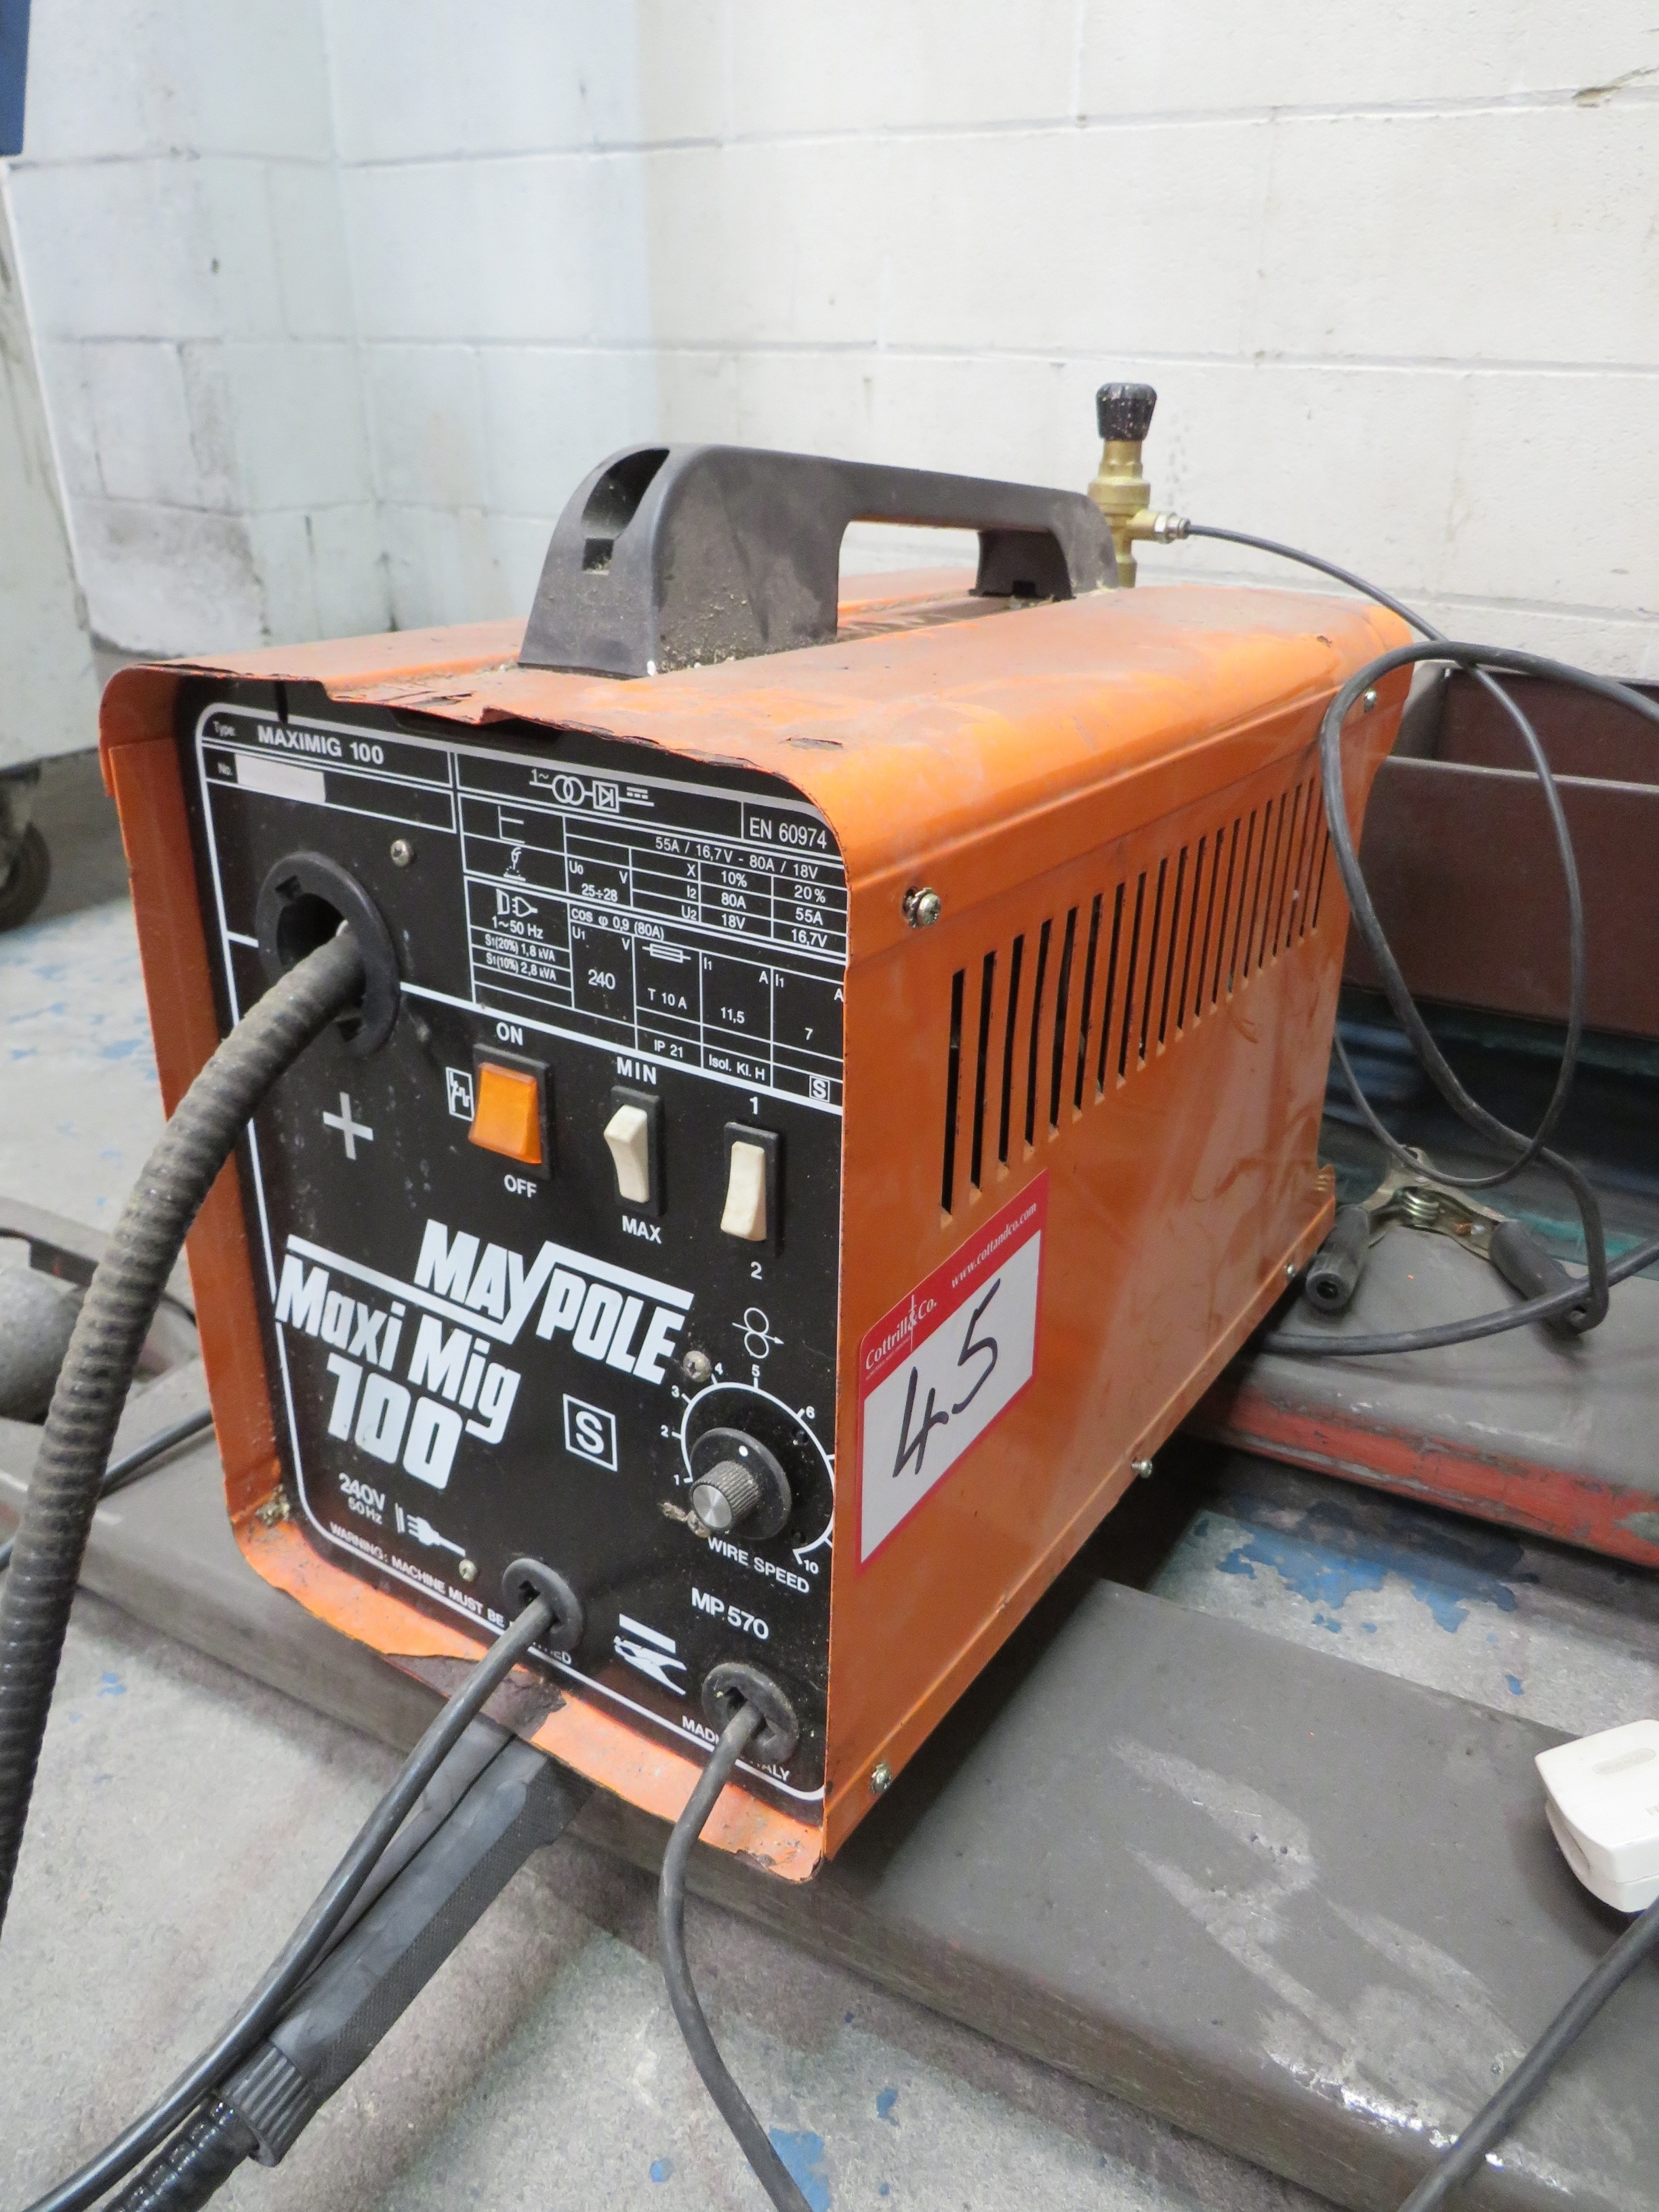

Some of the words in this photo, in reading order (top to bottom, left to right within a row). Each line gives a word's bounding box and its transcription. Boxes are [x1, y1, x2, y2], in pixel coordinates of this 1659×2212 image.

[258, 725, 342, 758] MAXIMIG
[350, 742, 385, 765] 100
[750, 817, 773, 840] EN
[779, 823, 827, 849] 60974
[655, 836, 680, 853] 55A
[750, 855, 775, 872] 80A
[794, 863, 819, 880] 18V
[619, 870, 628, 884] V
[686, 863, 697, 878] X
[721, 870, 747, 888] 10%
[794, 884, 826, 903] 20%
[721, 891, 747, 909] 80A
[795, 907, 823, 926] 55A
[527, 922, 544, 939] Hz
[612, 916, 630, 932] 0,9
[634, 920, 664, 941] (80A)
[721, 914, 746, 930] 18V
[791, 928, 827, 948] 16,7V
[521, 943, 536, 958] 1,8
[621, 937, 630, 951] V
[520, 962, 538, 977] 2,8
[588, 968, 616, 990] 240
[758, 970, 769, 985] A
[647, 987, 656, 1001] T
[661, 992, 676, 1006] 10
[678, 996, 688, 1010] A
[834, 987, 844, 1002] A
[720, 1006, 745, 1024] 11,5
[495, 1021, 524, 1046] ON
[804, 1027, 813, 1040] 7
[654, 1039, 665, 1052] IP
[670, 1044, 683, 1058] 21
[616, 1056, 657, 1085] MIN
[755, 1067, 765, 1081] H
[749, 1096, 759, 1115] 1
[503, 1174, 537, 1198] OFF
[621, 1215, 662, 1244] MAX
[950, 1202, 1038, 1289] www.cottandco.com
[750, 1261, 762, 1280] 2
[414, 1219, 687, 1386] MAYPOLE
[274, 1253, 407, 1371] Maxi
[407, 1313, 522, 1445] Mig
[714, 1362, 723, 1375] 4
[751, 1364, 760, 1378] 5
[891, 1277, 1001, 1478] 45
[671, 1385, 680, 1398] 3
[327, 1352, 464, 1490] 100
[805, 1406, 815, 1419] 6
[660, 1425, 669, 1438] 2
[673, 1474, 680, 1486] 1
[339, 1472, 386, 1511] 240V
[708, 1536, 749, 1567] WIRE
[754, 1557, 811, 1594] SPEED
[802, 1559, 819, 1575] 10
[391, 1555, 446, 1595] MACHINE
[448, 1586, 483, 1615] MUST
[487, 1607, 505, 1628] BE
[691, 1586, 725, 1616] MP
[727, 1604, 770, 1641] 570
